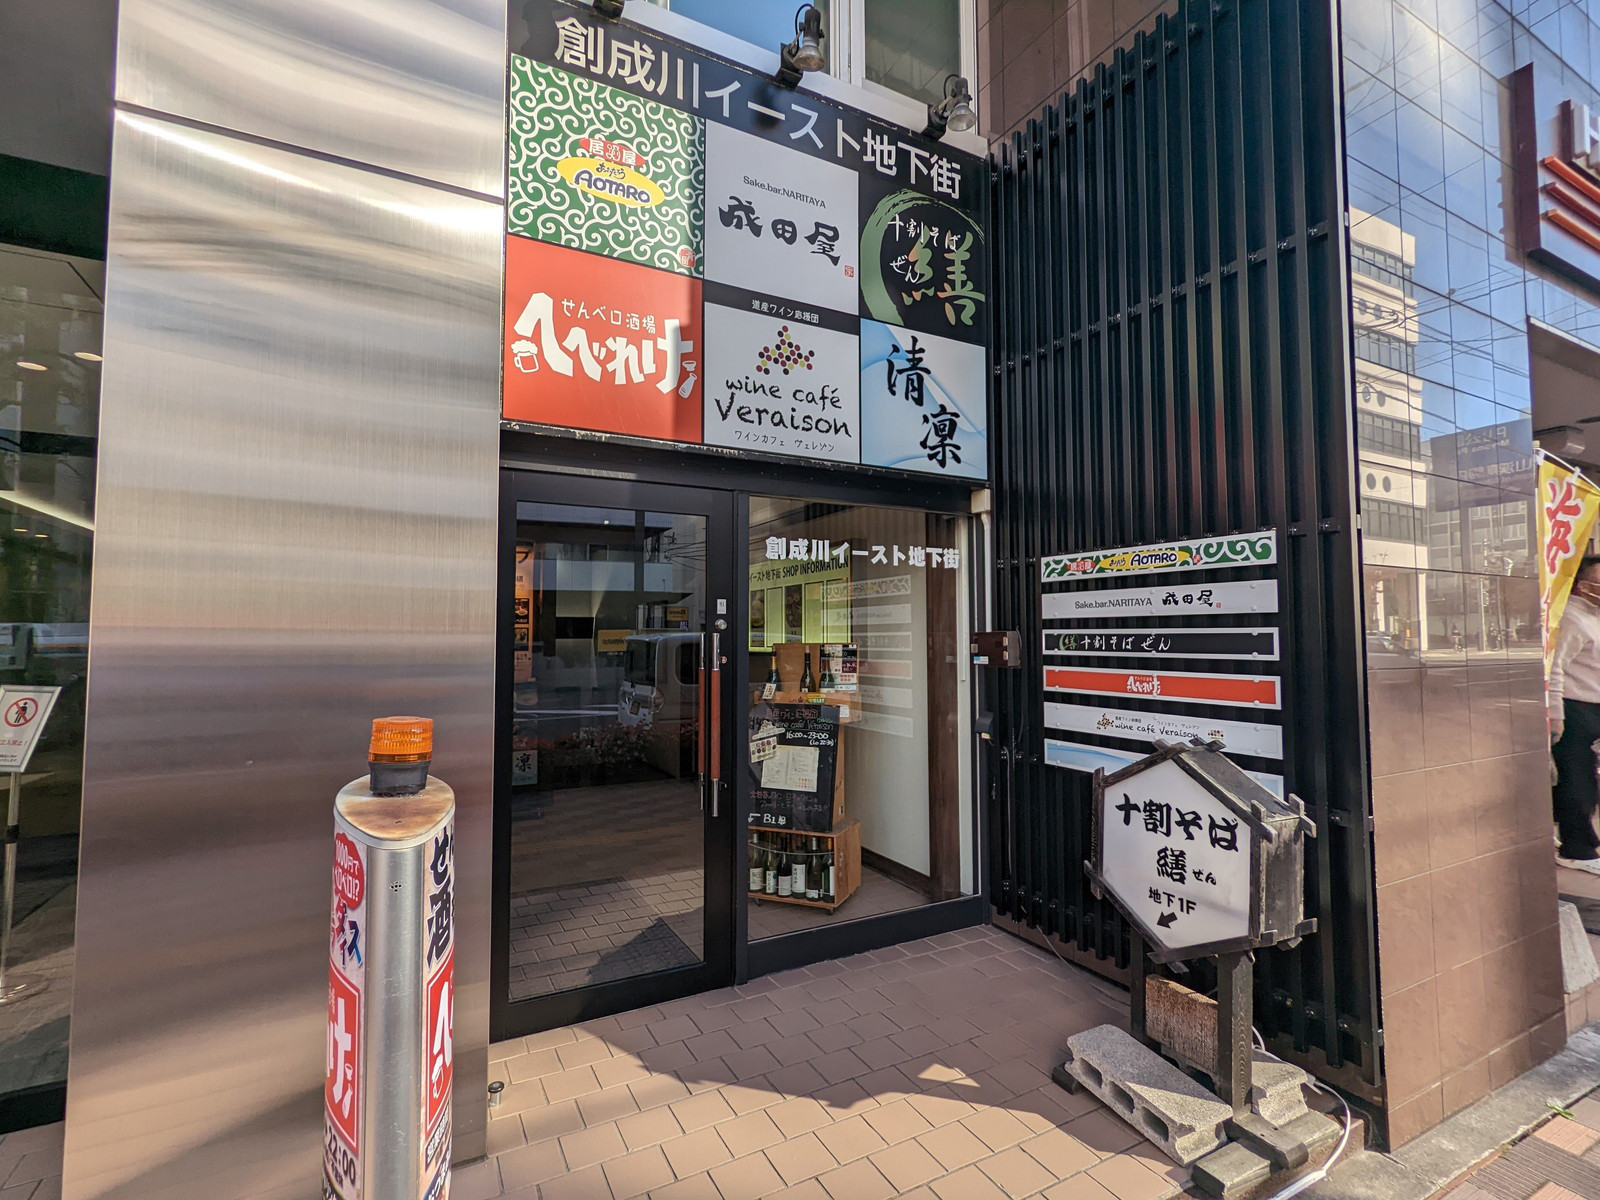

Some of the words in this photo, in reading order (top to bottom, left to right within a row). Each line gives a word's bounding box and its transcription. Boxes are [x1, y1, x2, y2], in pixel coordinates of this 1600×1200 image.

[554, 16, 961, 200] 創成川イースト地下街
[574, 169, 650, 204] AOTARO
[743, 175, 826, 209] Sake.bar.NARITAYA
[718, 195, 841, 267] 成田屋
[888, 213, 961, 253] 十割そば
[752, 299, 819, 324] 道産ワイン応援団
[726, 376, 782, 399] wine
[792, 384, 842, 412] café
[714, 391, 852, 438] Veraison
[765, 536, 960, 569] 創成川イースト地下街
[1129, 552, 1177, 567] AOTARO
[782, 564, 800, 578] SHOP
[1074, 597, 1153, 609] Sake.bar.NARITAYA
[1162, 589, 1213, 607] 成田屋
[1080, 634, 1135, 651] 十割そば
[1114, 722, 1135, 731] wine
[1136, 723, 1156, 734] café
[1159, 727, 1200, 740] Veraison
[1115, 793, 1239, 852] 十割そば
